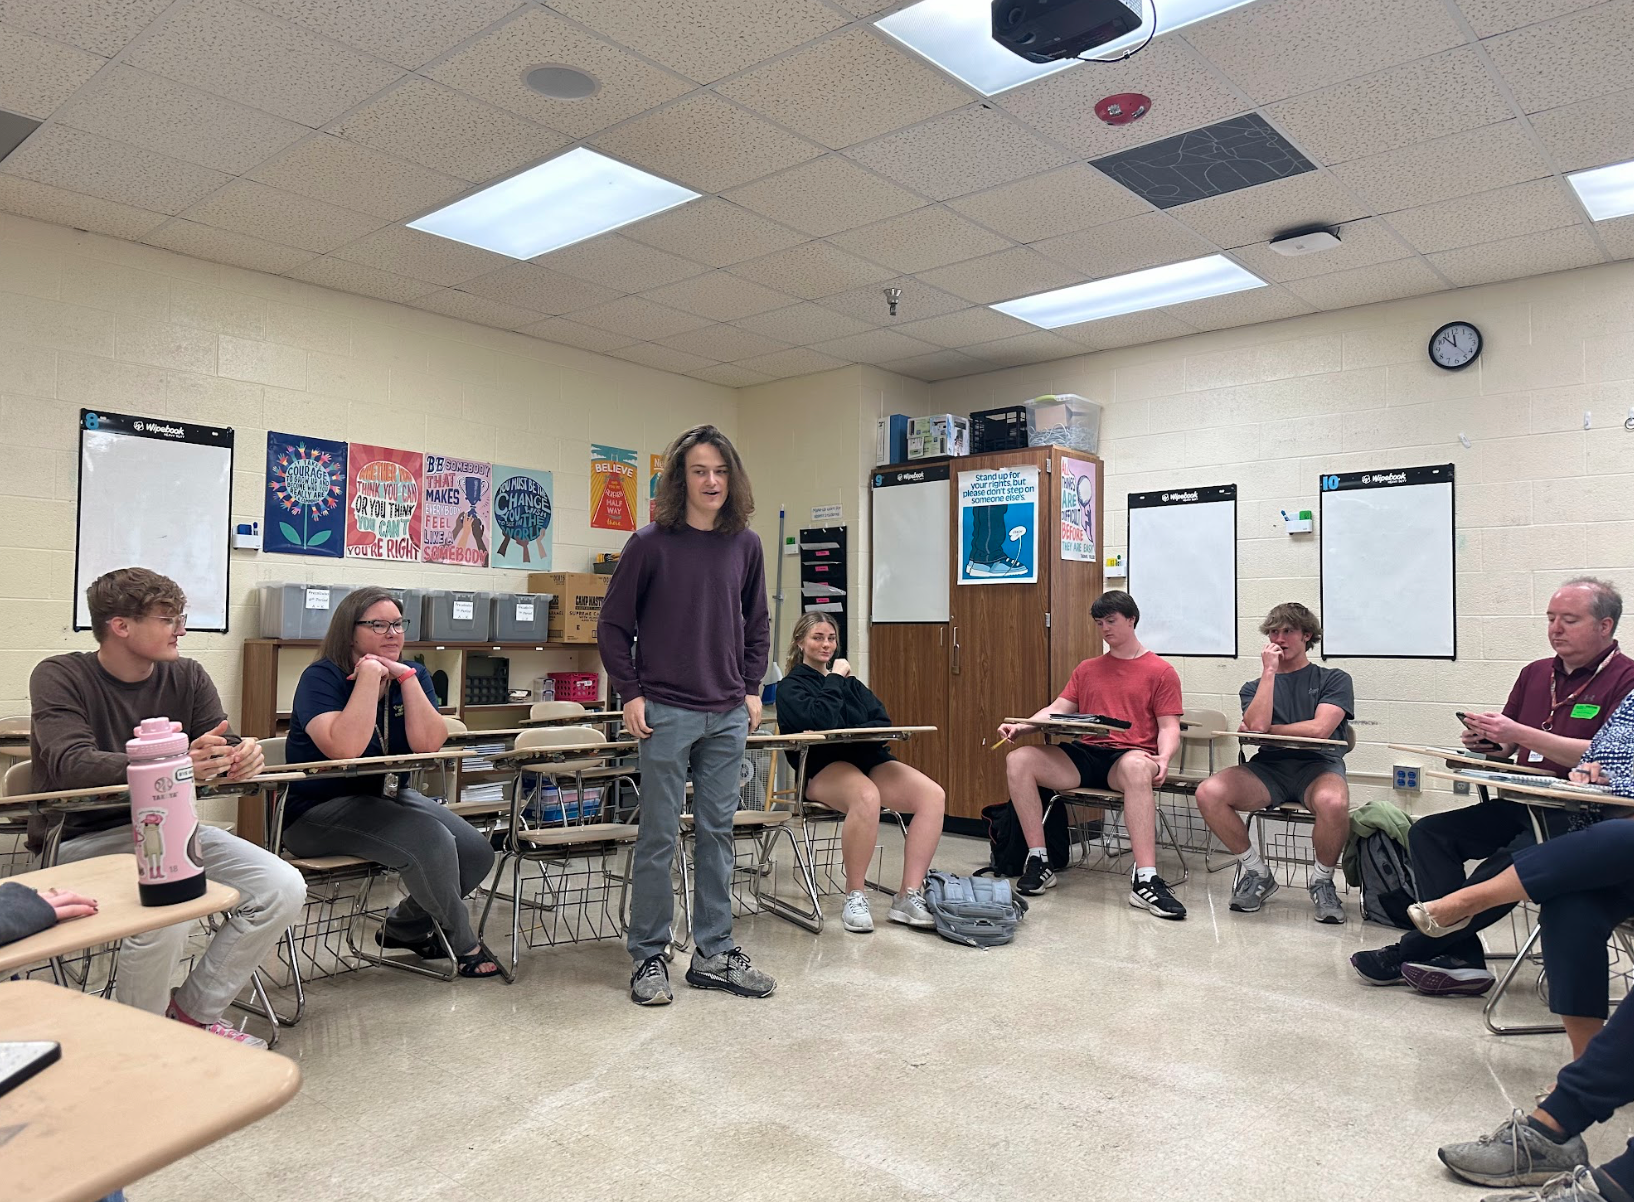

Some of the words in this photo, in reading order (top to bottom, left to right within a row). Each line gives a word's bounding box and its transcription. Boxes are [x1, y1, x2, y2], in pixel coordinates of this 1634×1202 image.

[86, 412, 99, 430] 8
[146, 423, 184, 436] Wipebook
[288, 466, 327, 480] COURAGE
[359, 462, 396, 482] WHETHER
[427, 456, 444, 473] BE
[445, 460, 490, 477] SOMEBODY
[595, 463, 633, 478] BELIEVE
[426, 473, 455, 488] THAT
[876, 475, 882, 486] 9
[989, 480, 1012, 488] rights,
[1062, 476, 1075, 492] THINGS
[1323, 475, 1339, 491] 10
[1372, 472, 1406, 483] Wipebook
[290, 488, 312, 498] REALLY
[357, 481, 380, 498] THINK
[383, 482, 398, 502] YOU
[402, 482, 417, 503] CAN
[500, 482, 510, 493] YOU
[511, 478, 527, 491] MUST
[528, 480, 536, 493] BE
[426, 489, 459, 505] MAKES
[963, 490, 985, 498] please
[972, 496, 1004, 504] someone
[1062, 490, 1076, 508] ARE
[1170, 491, 1198, 501] Wipebook
[355, 495, 368, 515] OR
[370, 499, 386, 518] YOU
[388, 503, 415, 518] THINK
[426, 504, 461, 515] EVERYBODY
[494, 493, 551, 515] CHANGE
[502, 507, 520, 521] YOU
[524, 506, 546, 518] WISH
[521, 514, 544, 526] THE
[1062, 509, 1080, 526] DIFFICULT
[357, 514, 376, 531] YOU
[379, 519, 410, 538] CAN'T
[426, 515, 450, 528] FEEL
[424, 529, 444, 544] LIKE
[500, 526, 543, 540] WORLD
[1062, 523, 1083, 541] BEFORE
[348, 538, 383, 557] YOU'RE
[387, 538, 419, 560] RIGHT
[1062, 541, 1072, 551] THEY
[1073, 542, 1081, 552] ARE
[1084, 544, 1093, 553] EASY
[424, 546, 488, 564] SOMEBODY
[576, 596, 588, 605] CAMP
